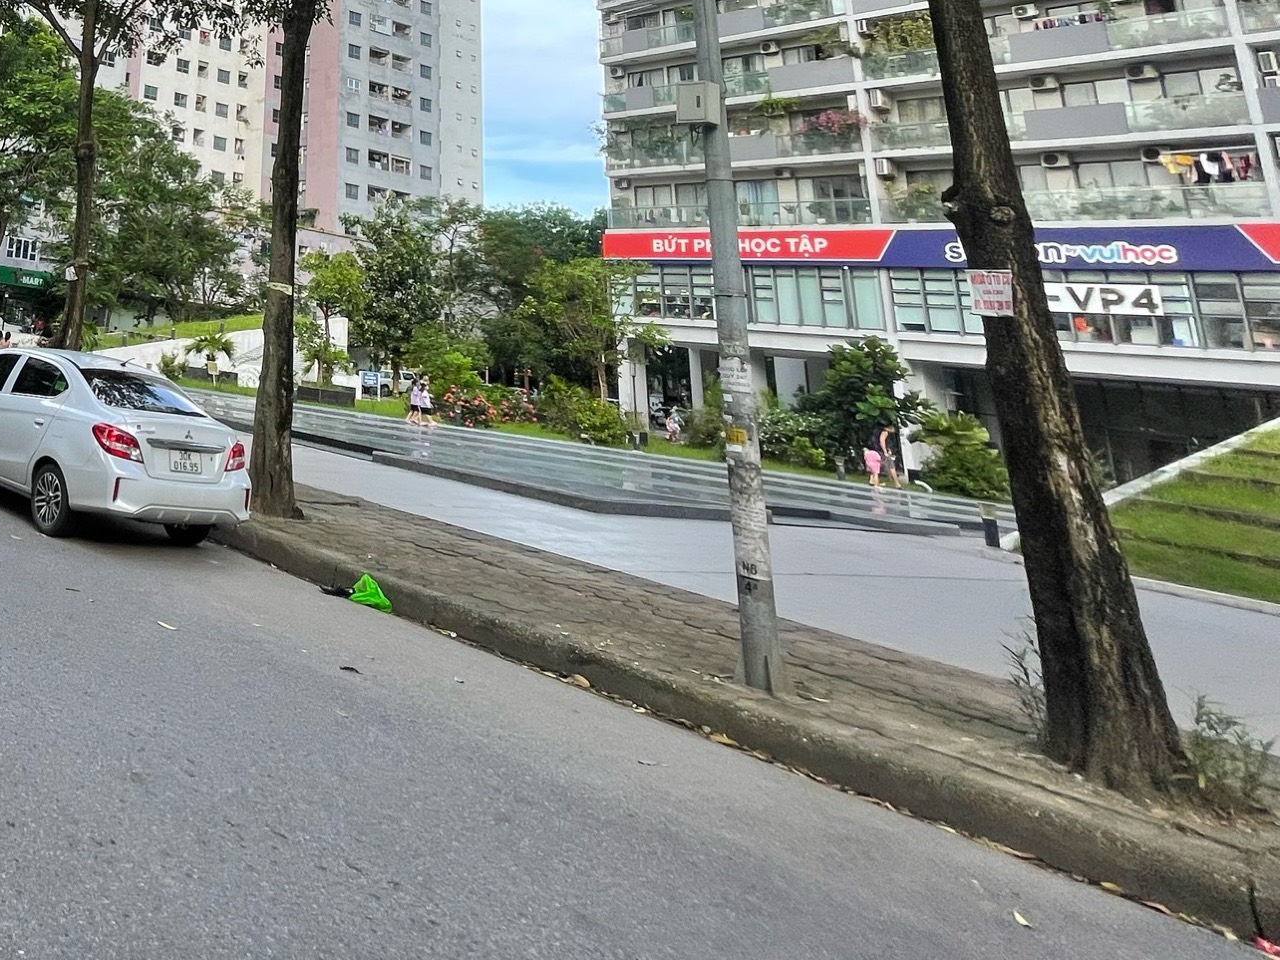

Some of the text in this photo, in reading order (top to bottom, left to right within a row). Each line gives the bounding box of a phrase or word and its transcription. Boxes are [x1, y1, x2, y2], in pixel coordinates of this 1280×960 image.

[652, 235, 689, 253] BỨT
[738, 238, 781, 257] HỌC
[786, 234, 828, 258] TẬP
